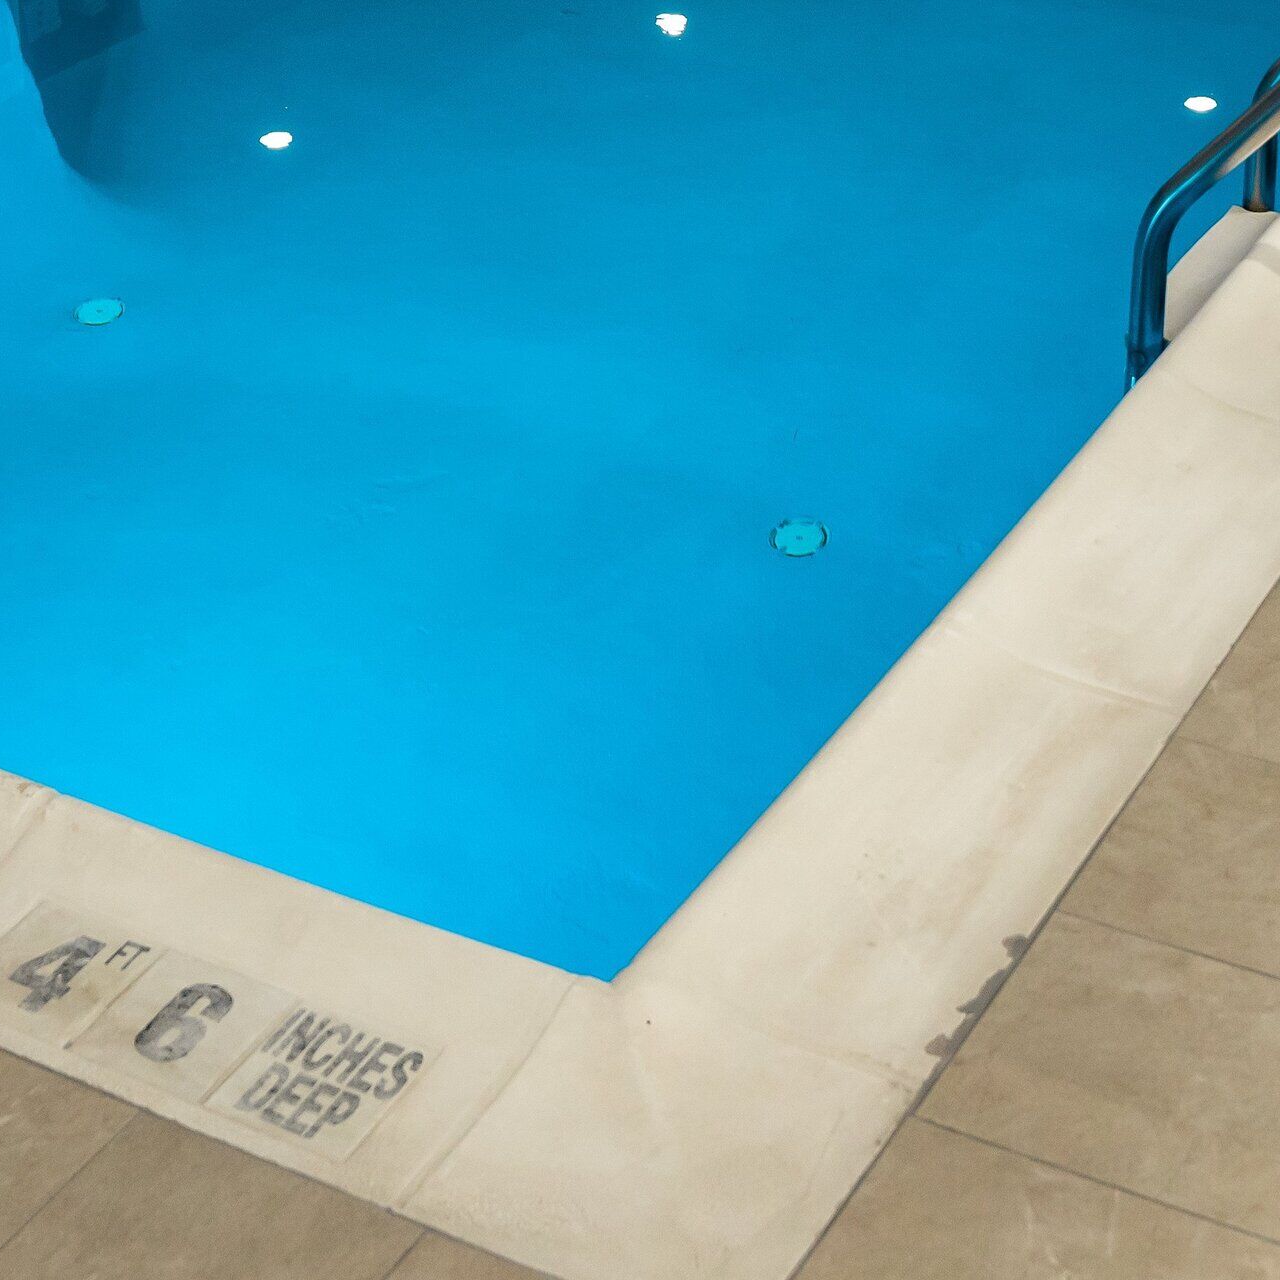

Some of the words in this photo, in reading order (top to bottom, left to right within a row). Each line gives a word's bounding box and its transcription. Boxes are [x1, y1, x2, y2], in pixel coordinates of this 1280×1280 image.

[9, 935, 106, 1013] 4
[104, 940, 151, 970] FT
[134, 983, 234, 1063] 6
[234, 1062, 361, 1138] DEEP
[262, 1007, 423, 1101] INCHES
